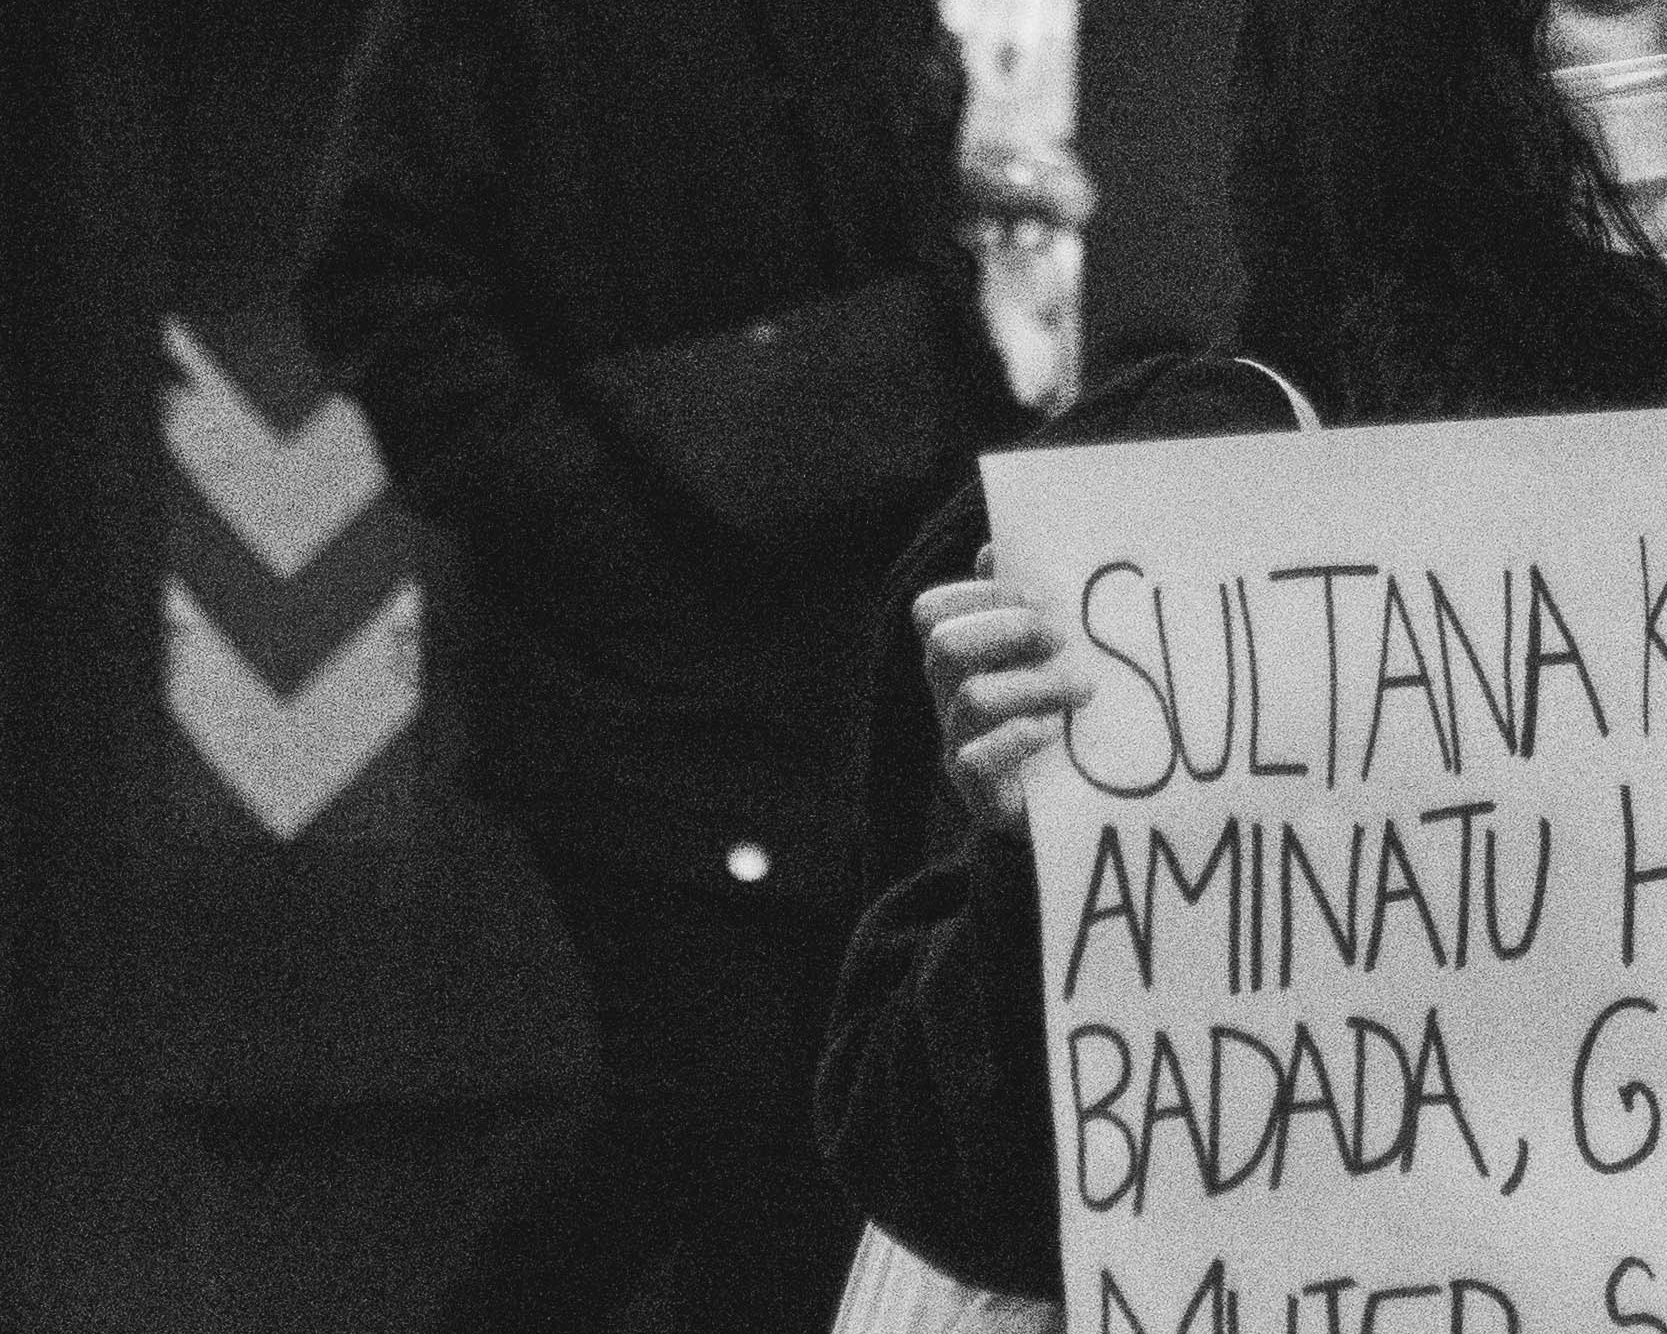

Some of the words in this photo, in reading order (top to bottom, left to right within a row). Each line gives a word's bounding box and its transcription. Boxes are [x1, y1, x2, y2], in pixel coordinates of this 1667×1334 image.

[1064, 559, 1609, 798] SULTANA
[1063, 801, 1551, 1002] AMINATU
[1068, 1007, 1529, 1215] BADADA,
